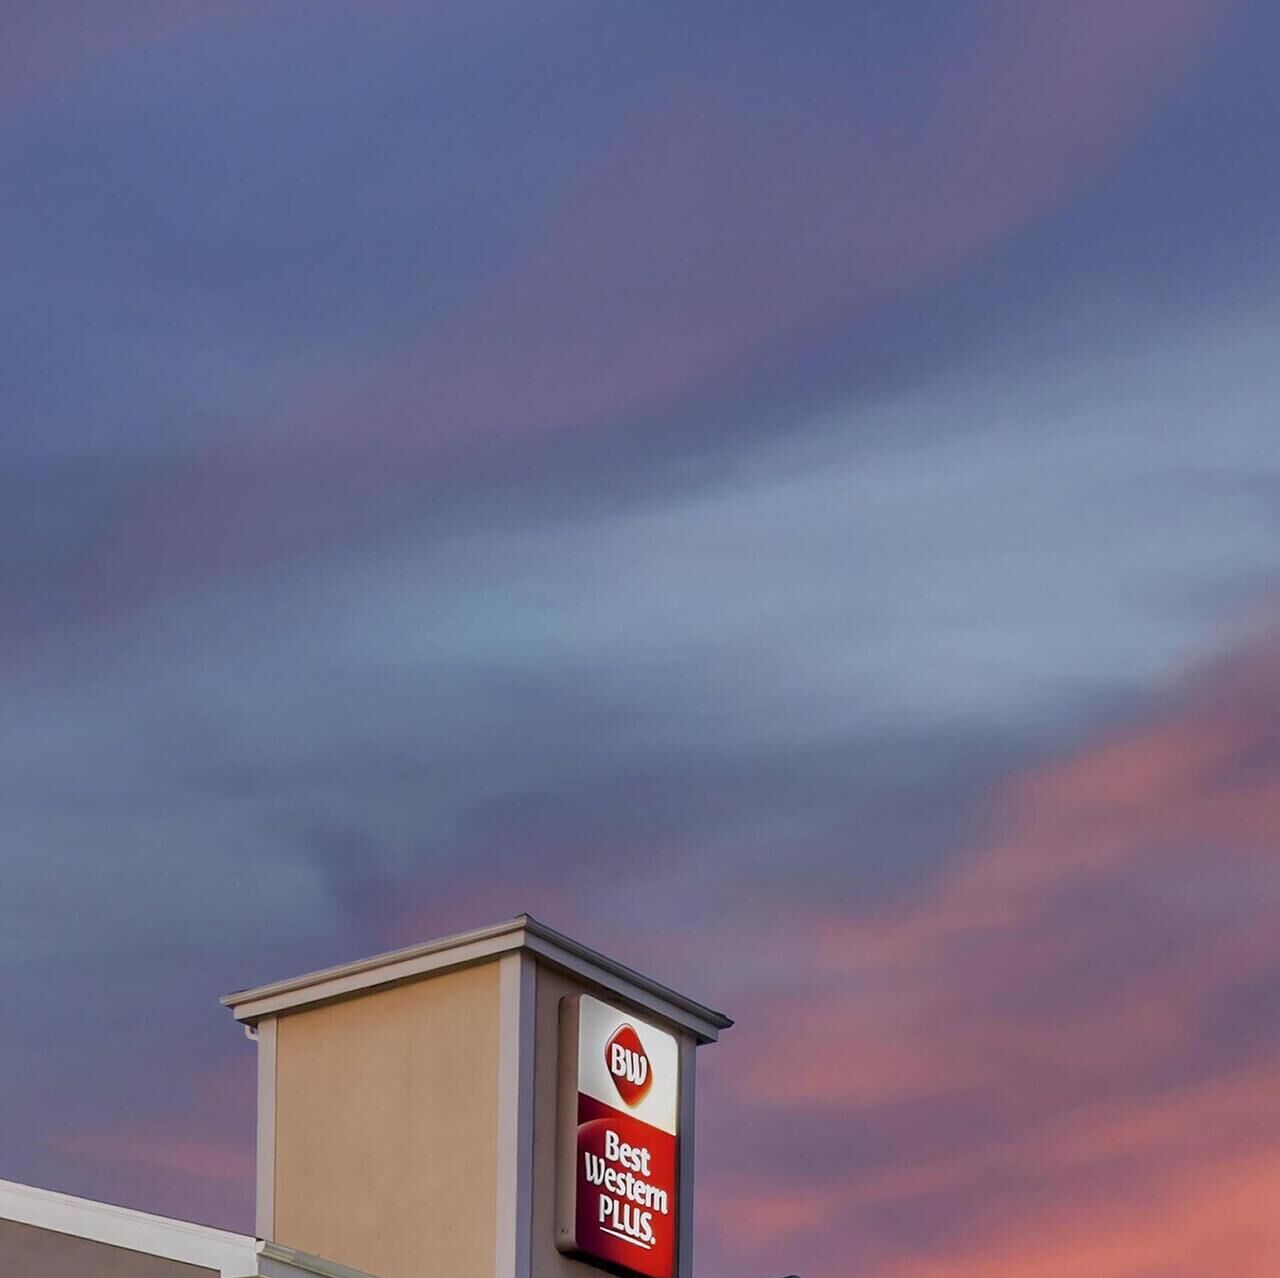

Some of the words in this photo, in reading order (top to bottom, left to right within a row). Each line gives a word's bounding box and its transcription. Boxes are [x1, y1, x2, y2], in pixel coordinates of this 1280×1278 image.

[611, 1043, 648, 1086] BW
[605, 1129, 651, 1177] Best
[584, 1151, 668, 1215] Western
